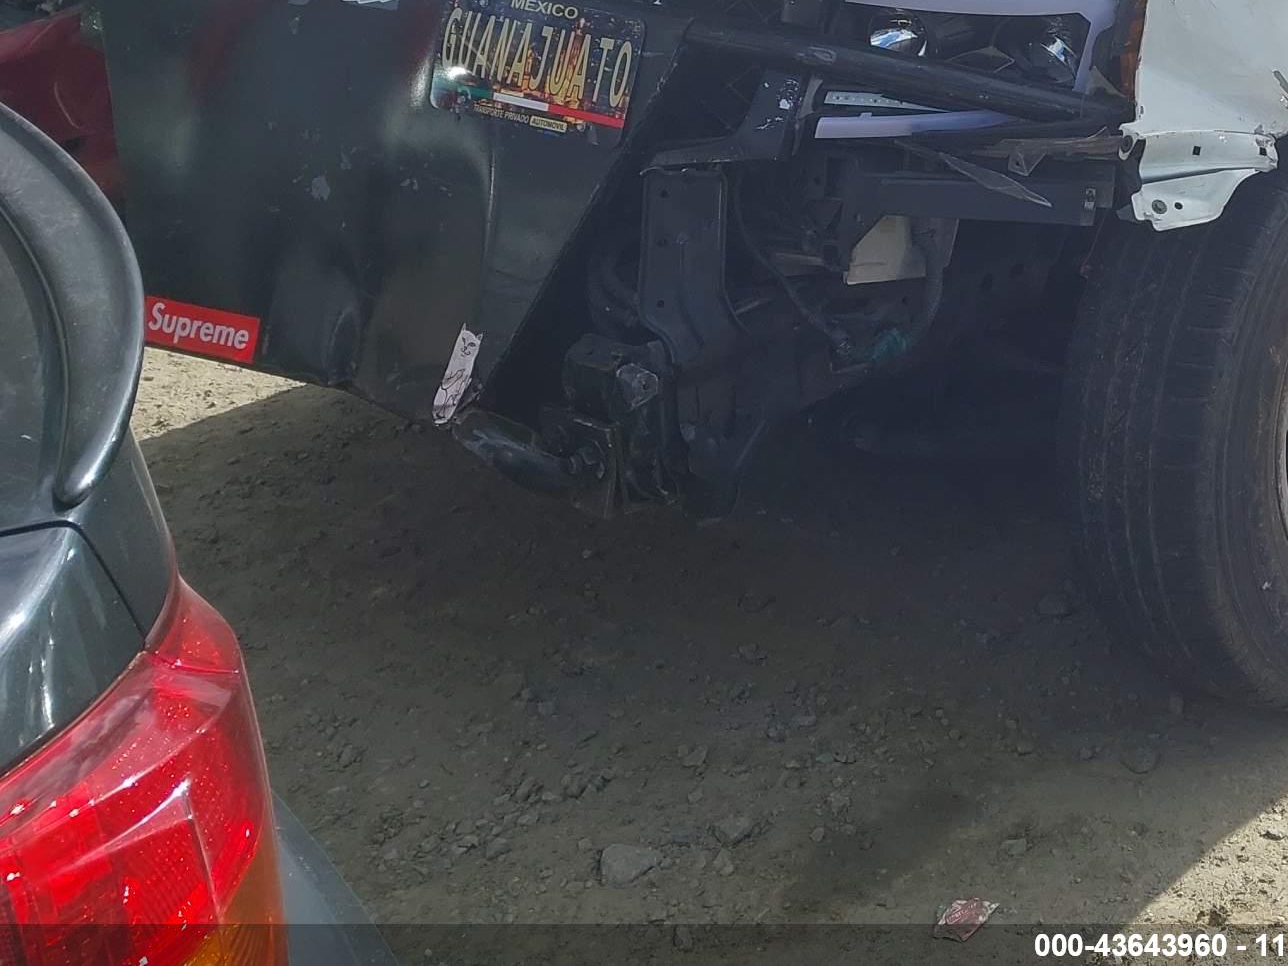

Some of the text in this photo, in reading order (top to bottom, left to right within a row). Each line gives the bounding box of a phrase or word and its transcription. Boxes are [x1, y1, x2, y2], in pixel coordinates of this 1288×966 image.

[442, 7, 632, 107] GUANAJUATO
[473, 104, 504, 119] TRANSPORTE
[504, 111, 529, 124] PRIVADO
[149, 303, 249, 349] Supreme
